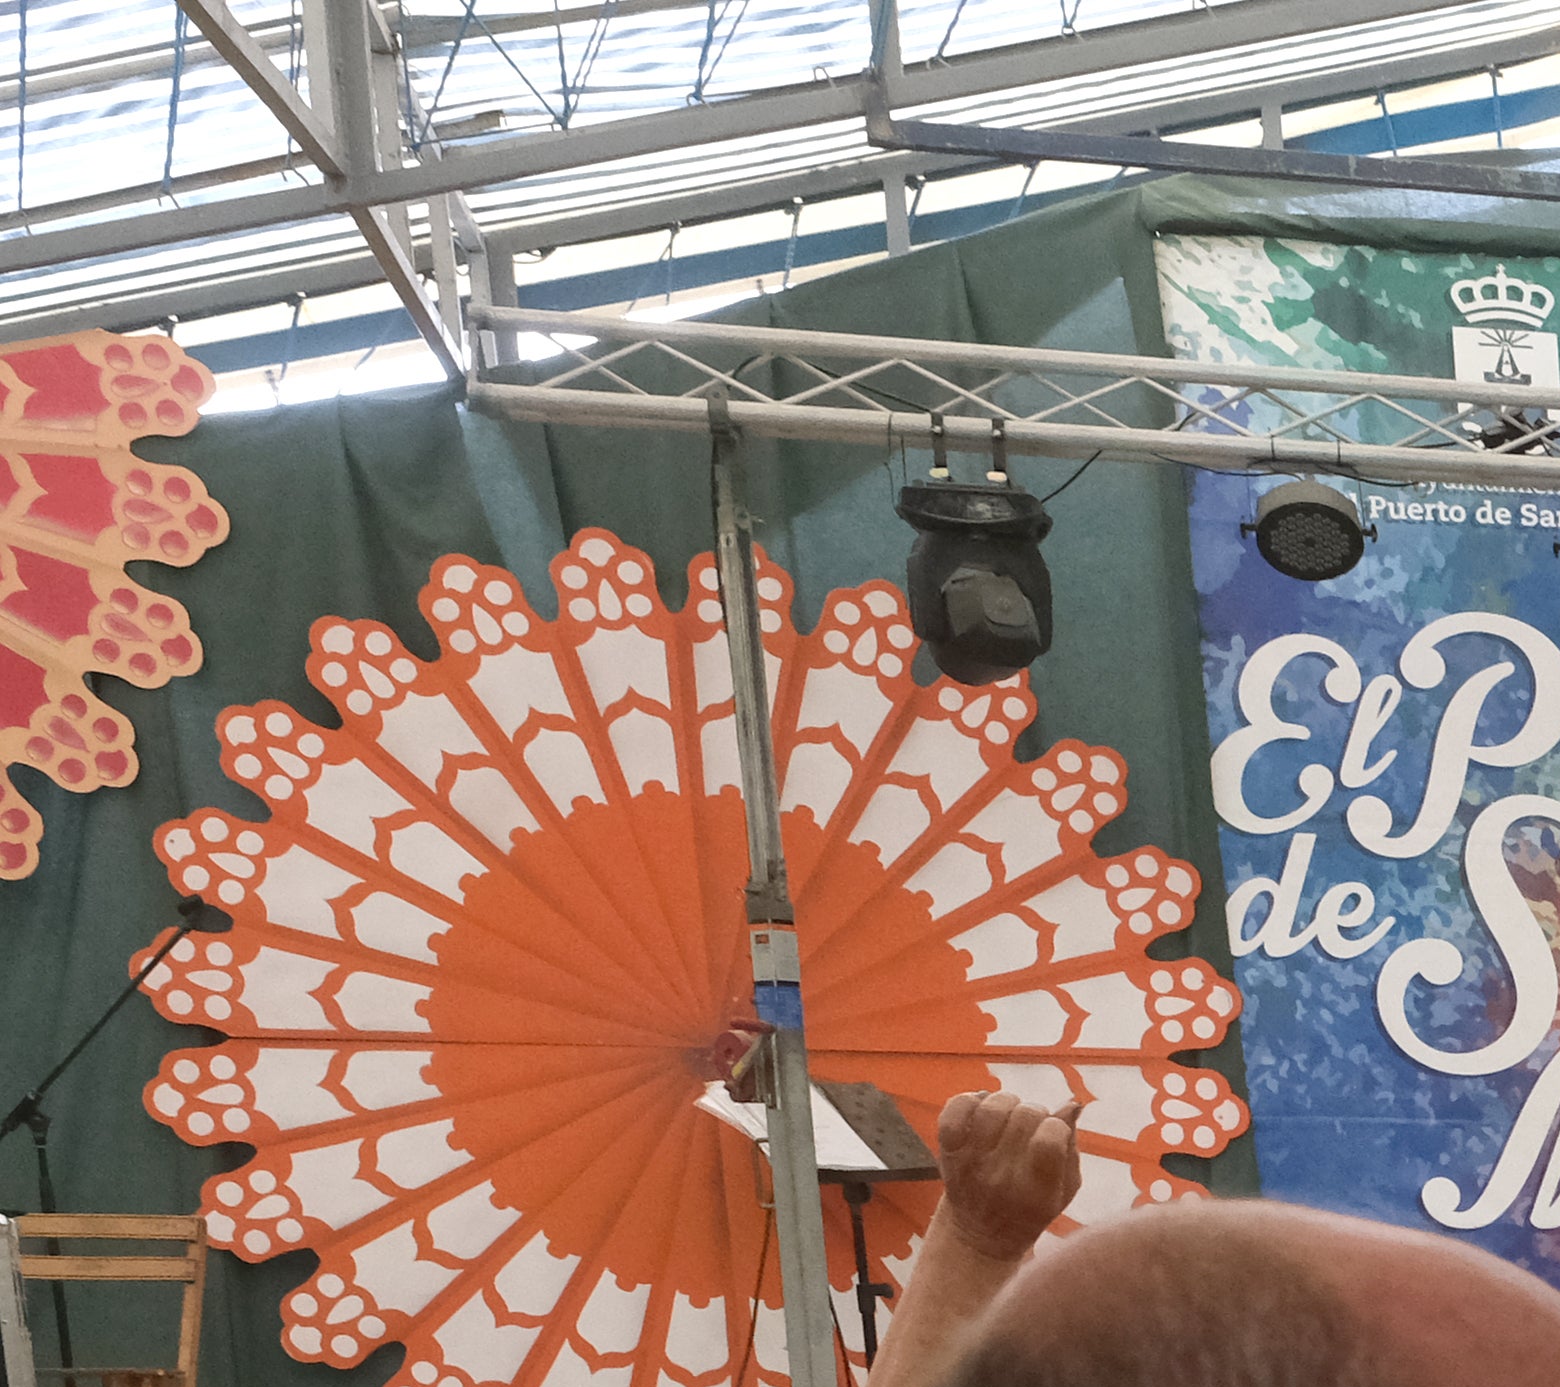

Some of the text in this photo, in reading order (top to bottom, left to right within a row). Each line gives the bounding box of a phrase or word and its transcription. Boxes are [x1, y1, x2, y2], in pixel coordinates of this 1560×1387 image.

[1368, 495, 1467, 523] Puerto
[1475, 499, 1517, 525] de
[1211, 633, 1402, 835] El
[1225, 833, 1396, 960] de
